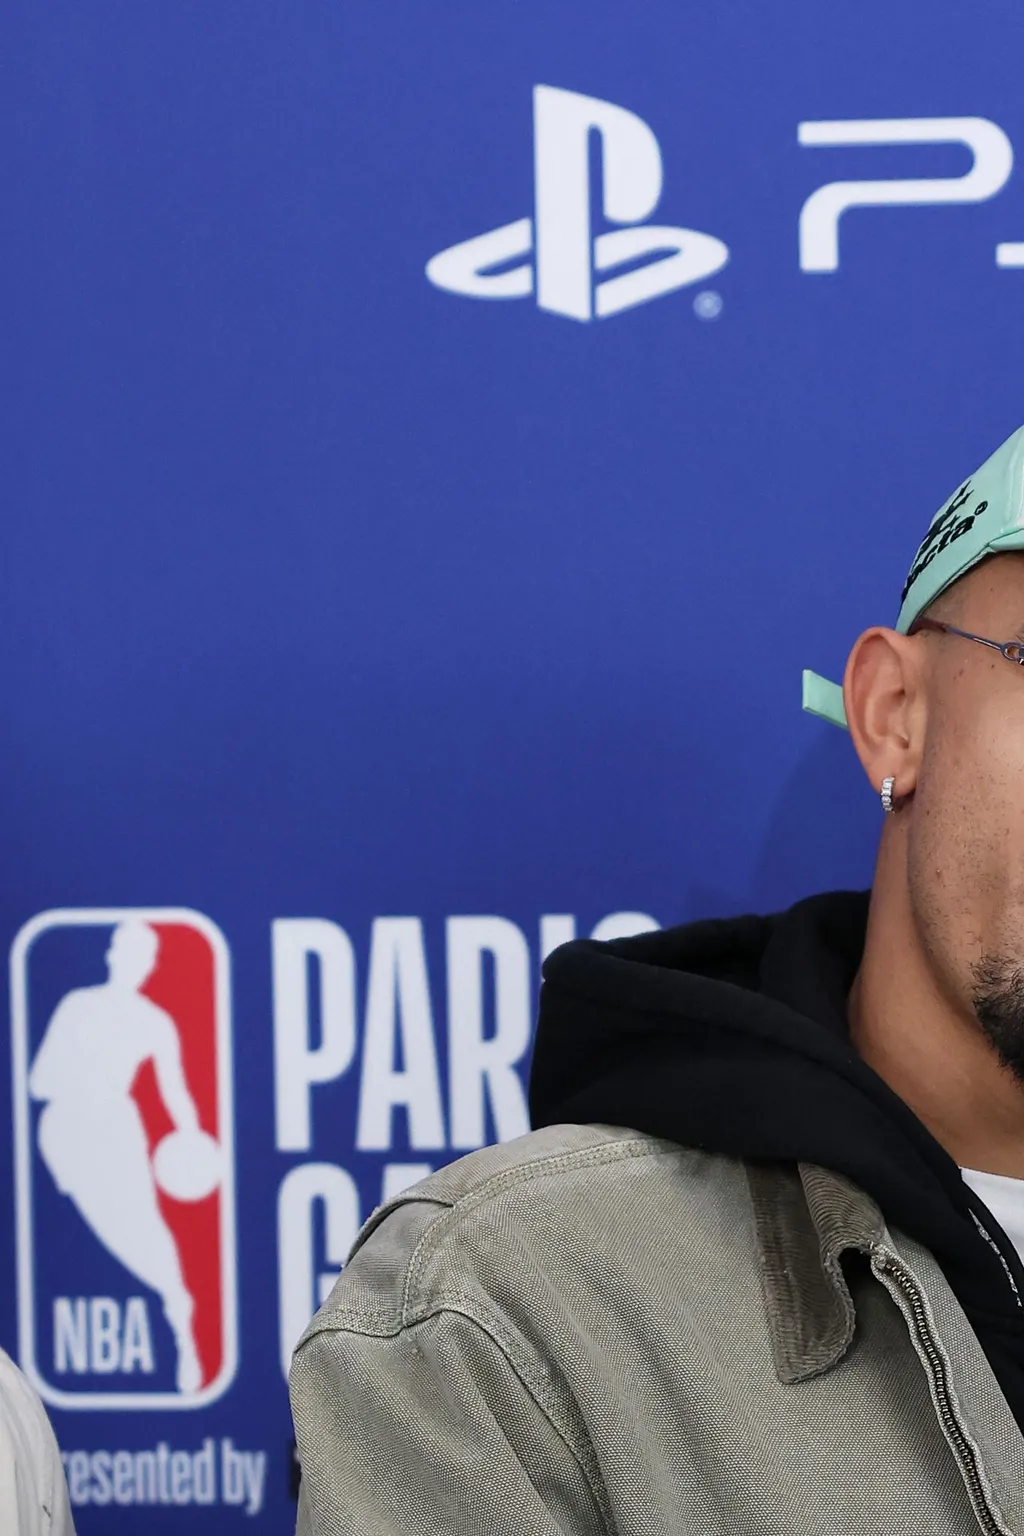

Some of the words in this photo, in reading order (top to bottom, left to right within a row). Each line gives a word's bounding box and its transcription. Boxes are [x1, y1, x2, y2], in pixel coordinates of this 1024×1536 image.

[271, 912, 664, 1152] PAR
[53, 1297, 154, 1374] NBA
[221, 1437, 266, 1516] by
